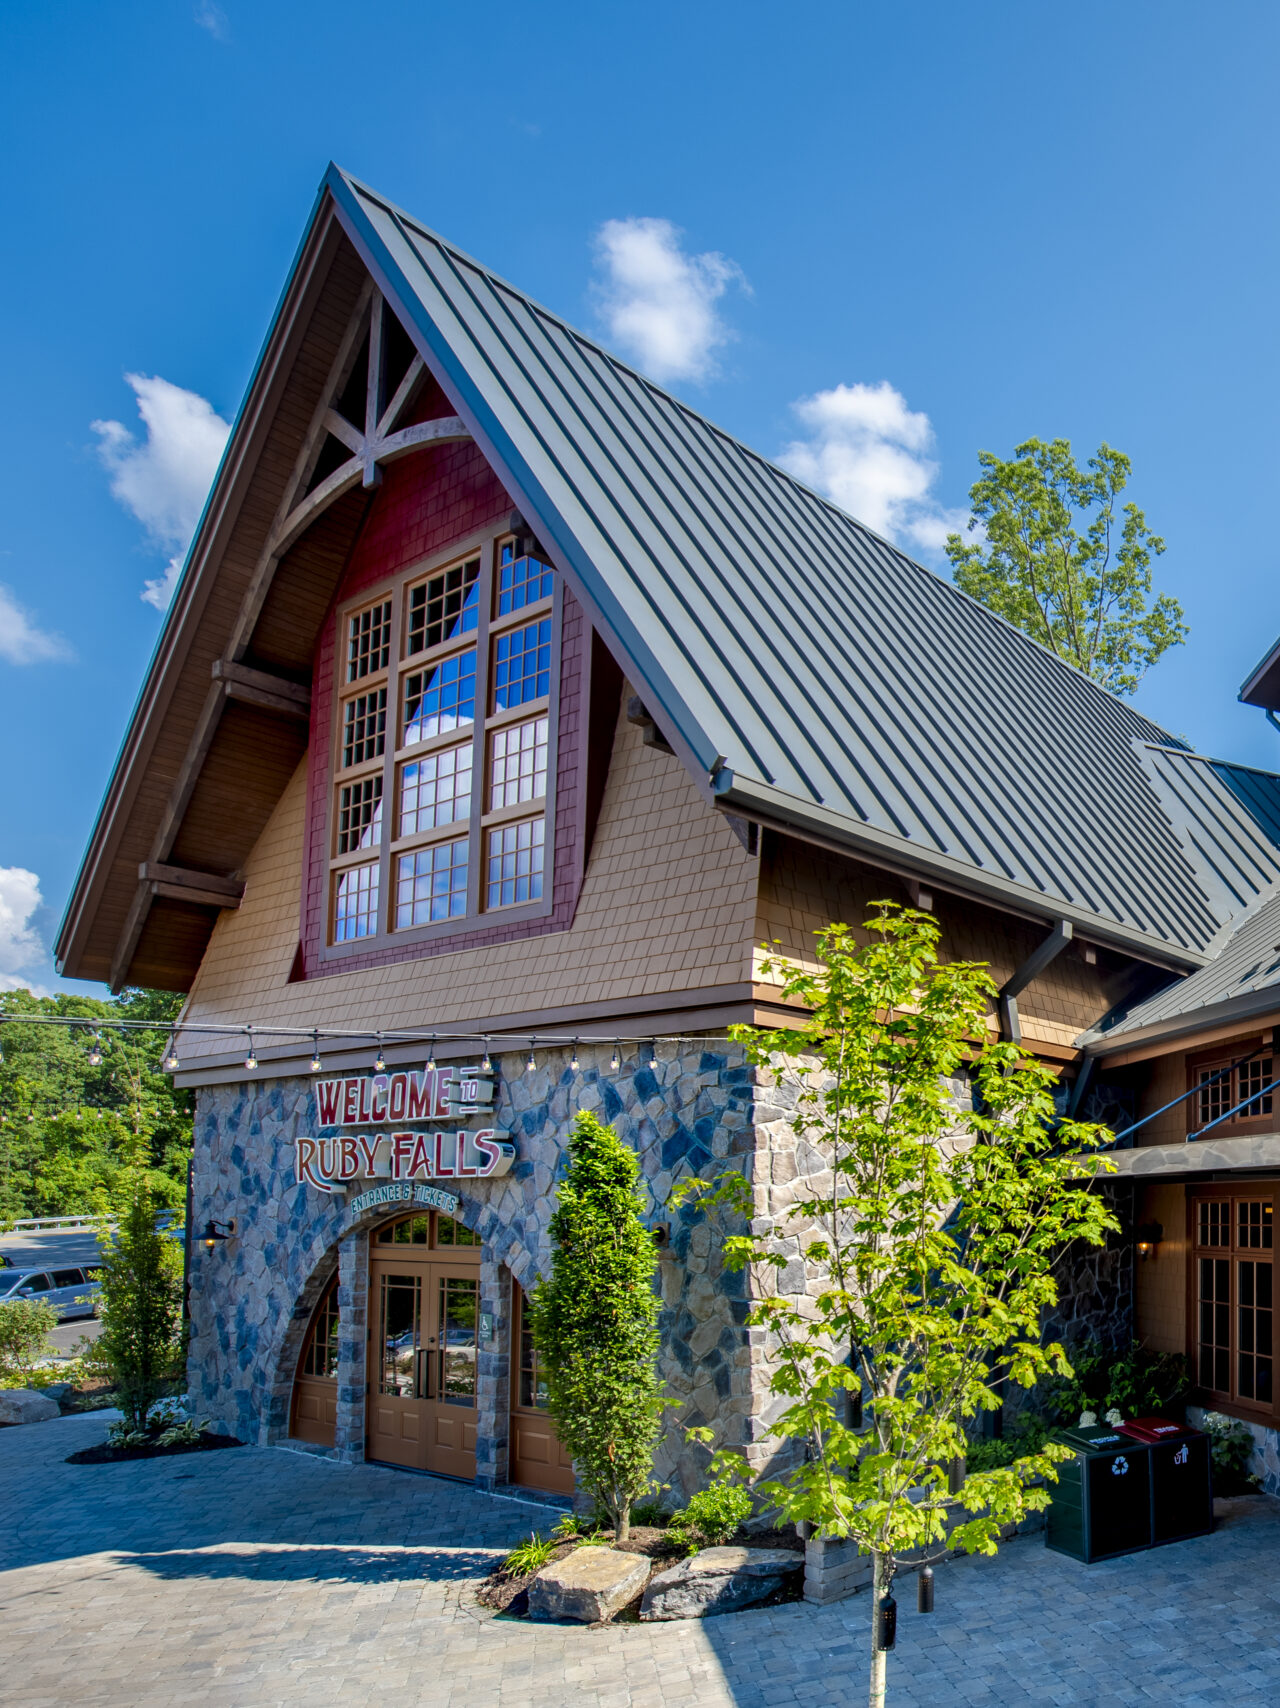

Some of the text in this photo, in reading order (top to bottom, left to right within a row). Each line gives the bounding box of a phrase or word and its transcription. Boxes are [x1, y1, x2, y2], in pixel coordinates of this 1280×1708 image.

[315, 1066, 478, 1127] WELCOME TO
[296, 1129, 501, 1193] RUBY FALLS
[350, 1183, 457, 1215] ENTRANCE & TICKETS
